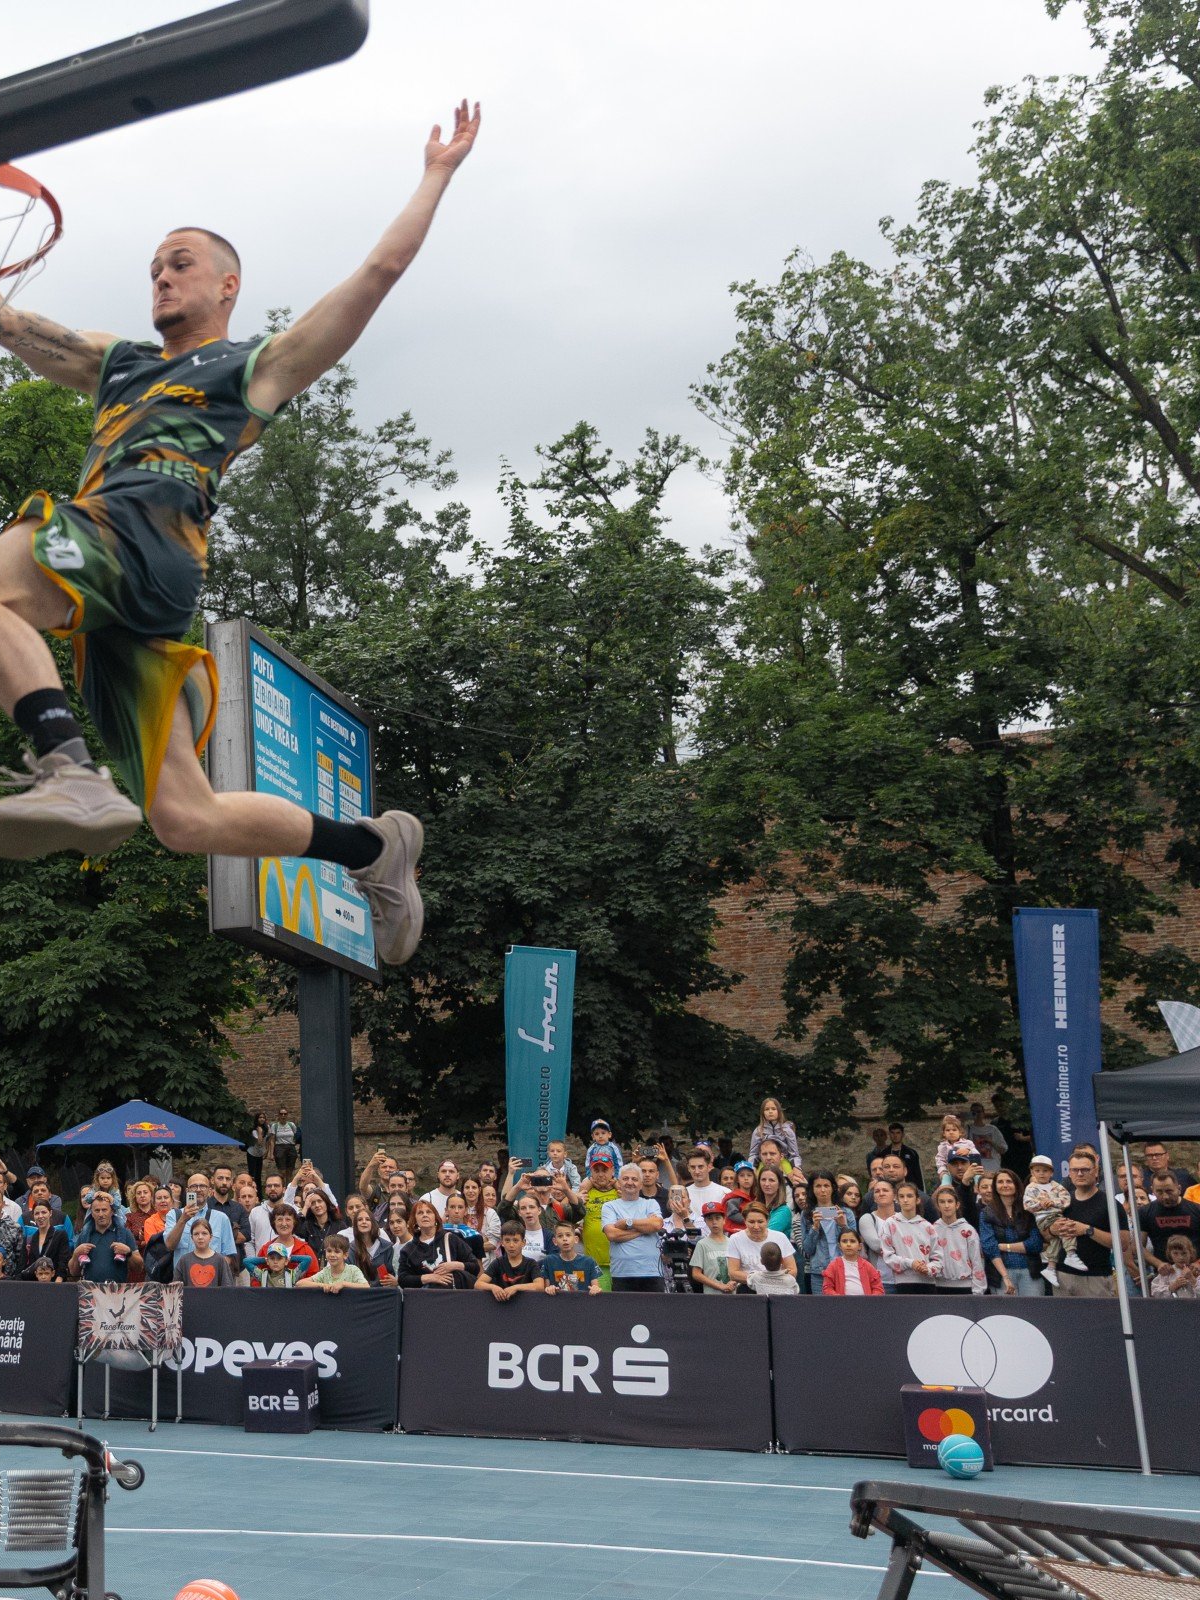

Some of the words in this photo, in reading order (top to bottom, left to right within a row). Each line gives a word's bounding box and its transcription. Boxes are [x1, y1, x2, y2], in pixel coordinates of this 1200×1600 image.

[253, 651, 274, 683] POFTA
[254, 678, 290, 722] ZBOARĂ
[255, 710, 273, 738] UNDE
[274, 720, 290, 749] VREA
[290, 734, 299, 754] EA
[342, 909, 351, 921] 400
[1052, 924, 1067, 1029] HEINNER
[517, 961, 559, 1053] fram
[1056, 1044, 1072, 1143] www.heinner.ro
[487, 1342, 601, 1394] BCR
[248, 1395, 281, 1411] BCR
